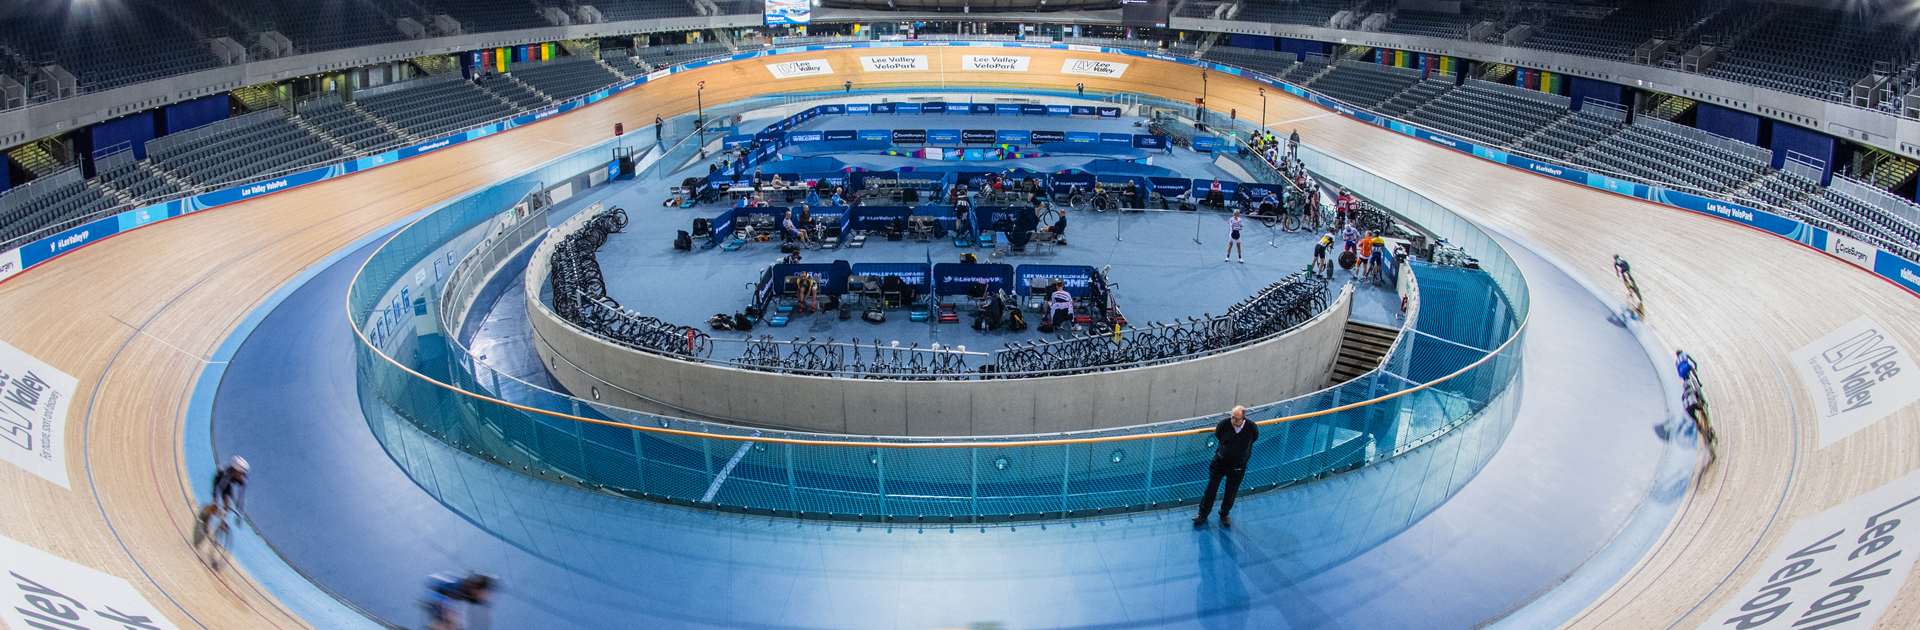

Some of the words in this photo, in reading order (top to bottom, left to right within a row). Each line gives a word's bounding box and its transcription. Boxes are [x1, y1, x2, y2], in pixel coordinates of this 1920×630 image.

[242, 187, 251, 196] Lee
[251, 183, 266, 195] Valley
[266, 179, 287, 190] VeloPark
[1707, 202, 1716, 212] Lee
[1717, 204, 1731, 217] Valley
[1731, 207, 1753, 221] VeloPark
[58, 230, 89, 250] @LeeValleyVP
[1022, 279, 1089, 287] WOME
[1870, 350, 1900, 382] Lee
[4, 370, 51, 411] Valley
[1818, 376, 1832, 388] sport
[1840, 366, 1872, 413] Valley
[43, 407, 53, 419] and
[41, 417, 54, 433] sport
[39, 450, 52, 461] For
[1848, 495, 1920, 561] Lee
